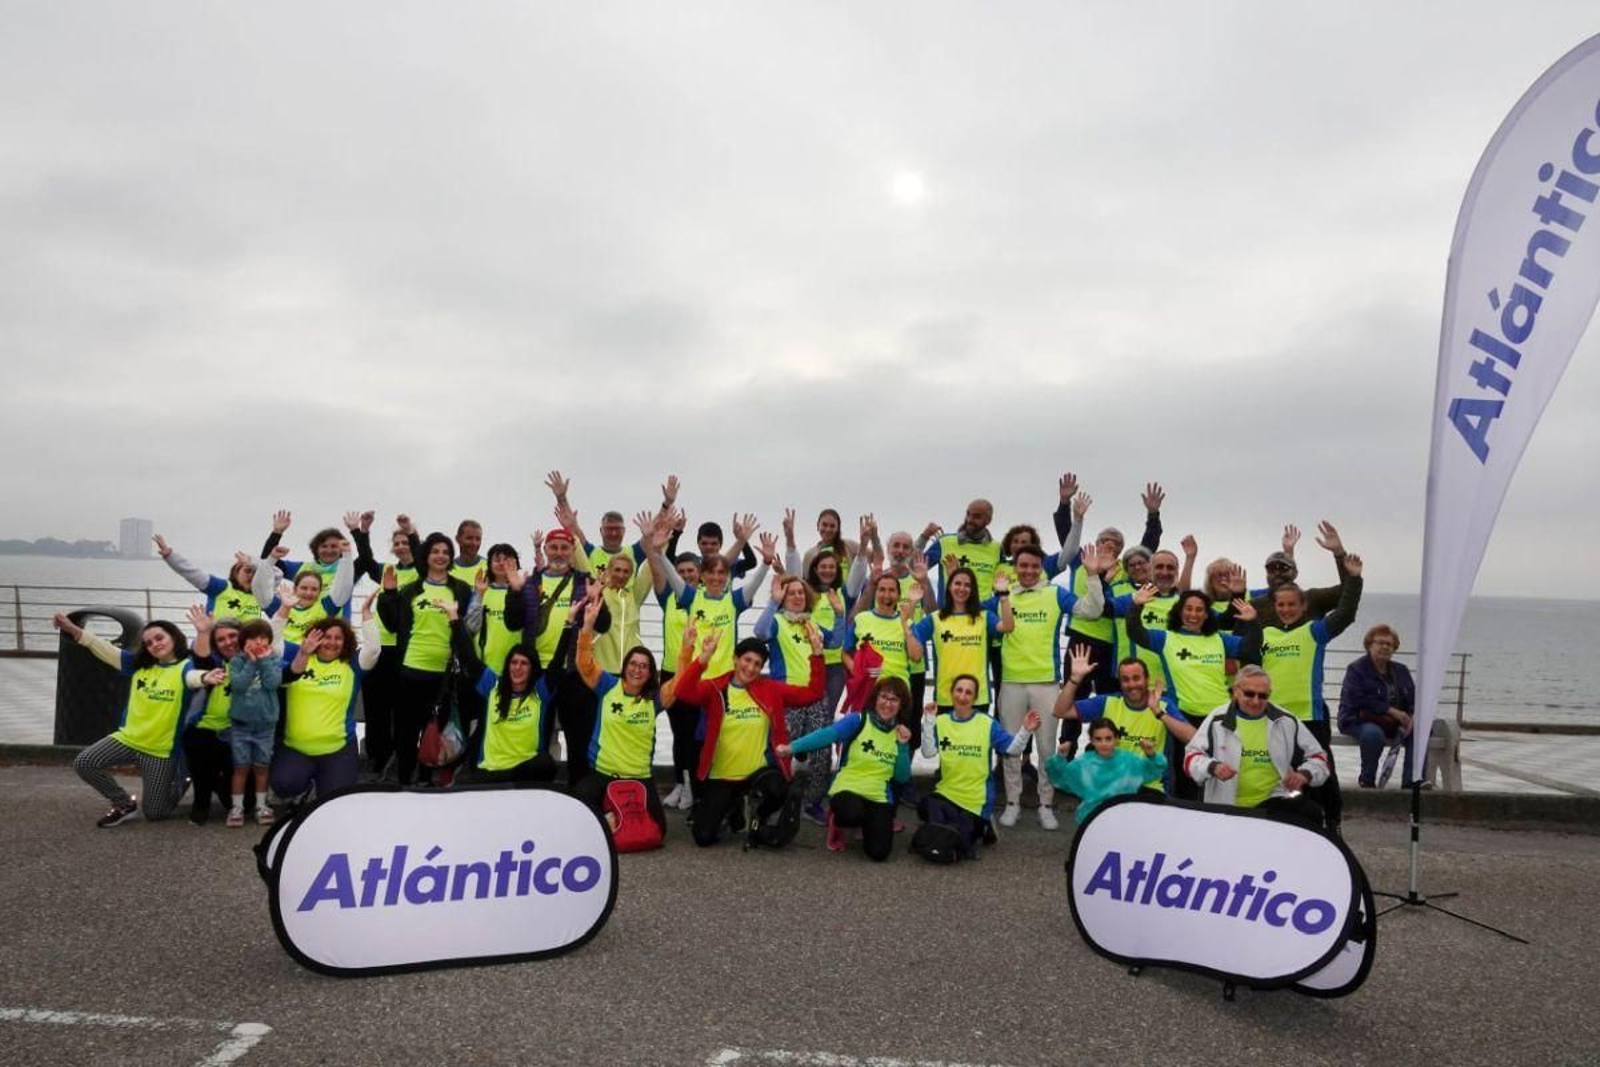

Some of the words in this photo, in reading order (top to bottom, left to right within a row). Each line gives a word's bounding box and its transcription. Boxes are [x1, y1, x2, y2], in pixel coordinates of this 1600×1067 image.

[1446, 99, 1600, 465] Atlántic
[871, 639, 904, 648] DEPORTE
[297, 839, 602, 912] Atlántico
[1083, 850, 1337, 936] Atlántico
